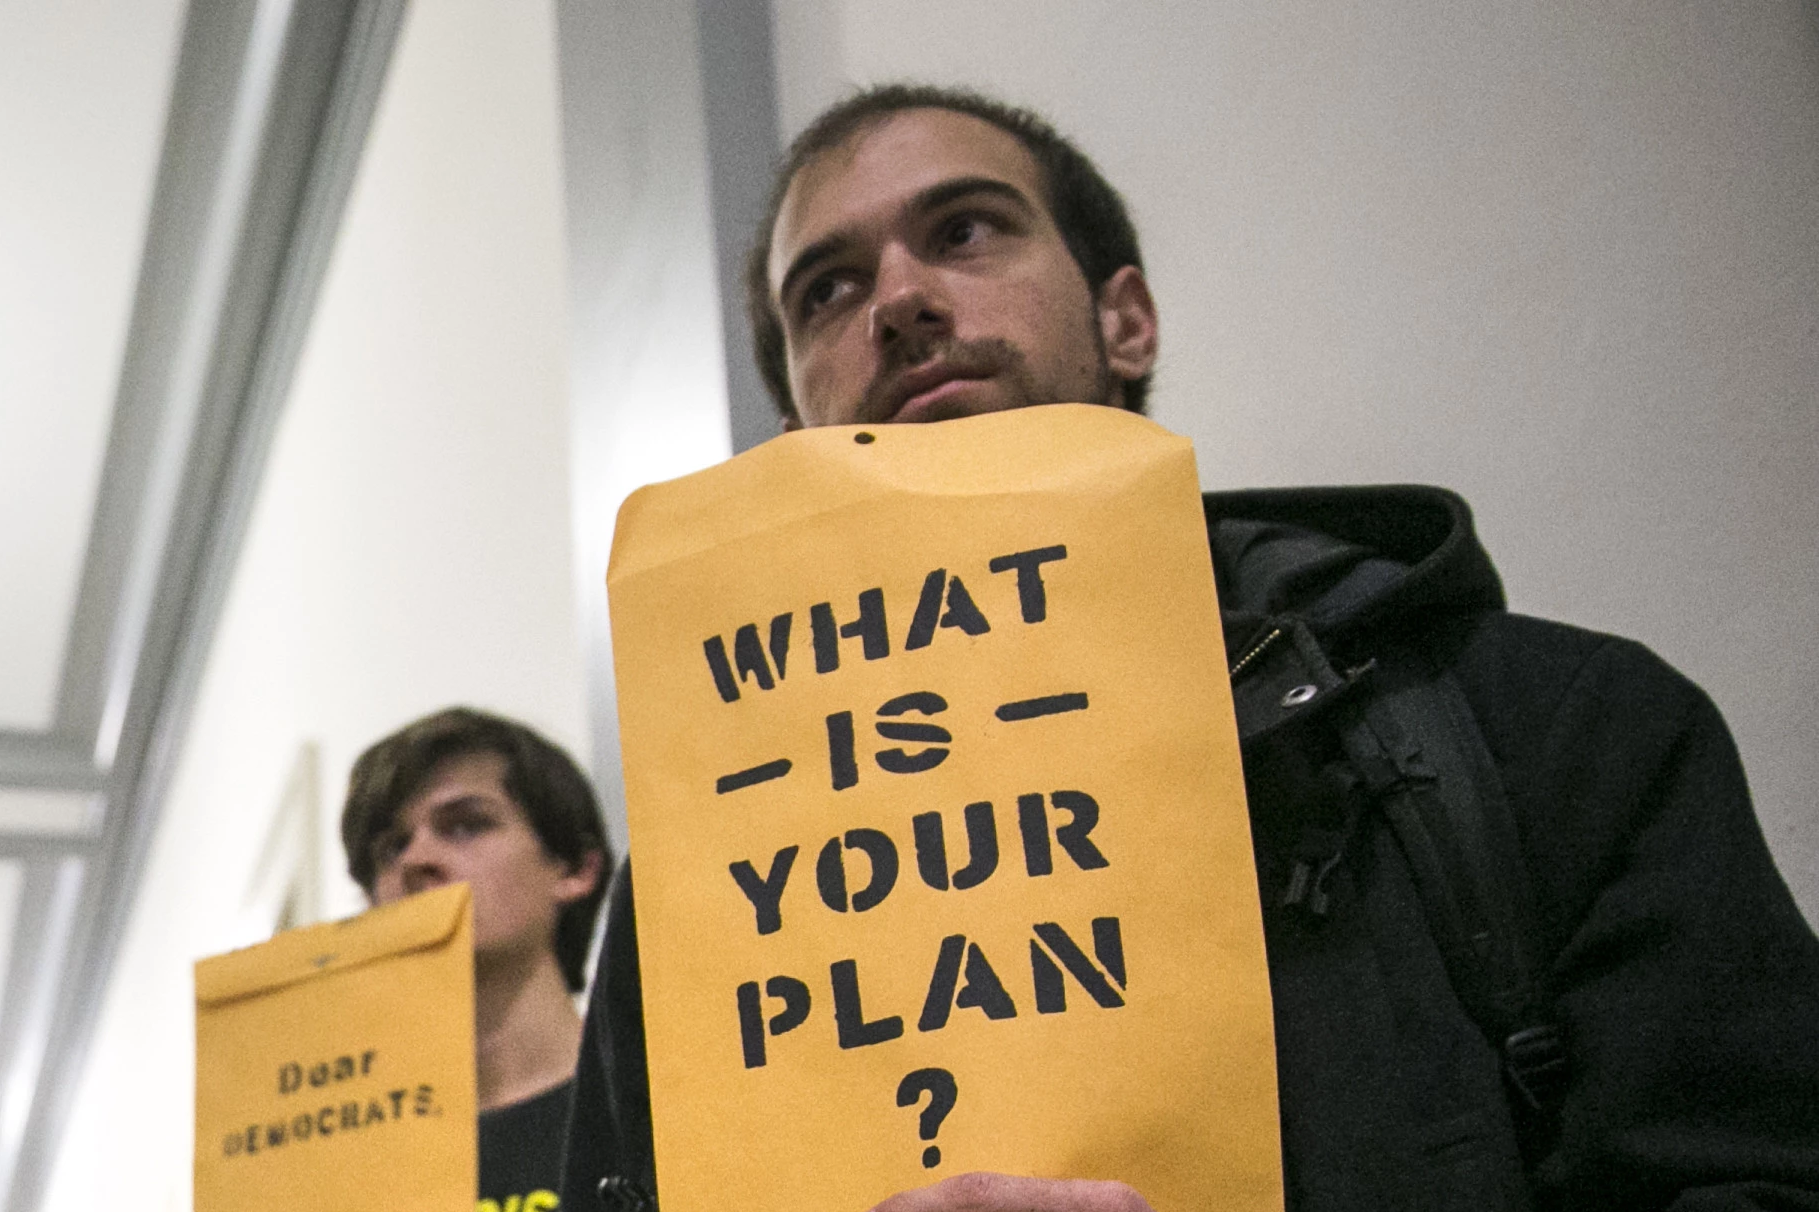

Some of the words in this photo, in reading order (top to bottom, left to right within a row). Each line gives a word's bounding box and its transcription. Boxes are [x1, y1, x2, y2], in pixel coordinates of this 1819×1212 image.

[703, 545, 1068, 703] WHAT
[826, 691, 953, 791] IS
[729, 790, 1110, 936] YOUR
[737, 917, 1127, 1069] PLAN
[896, 1068, 958, 1168] ?
